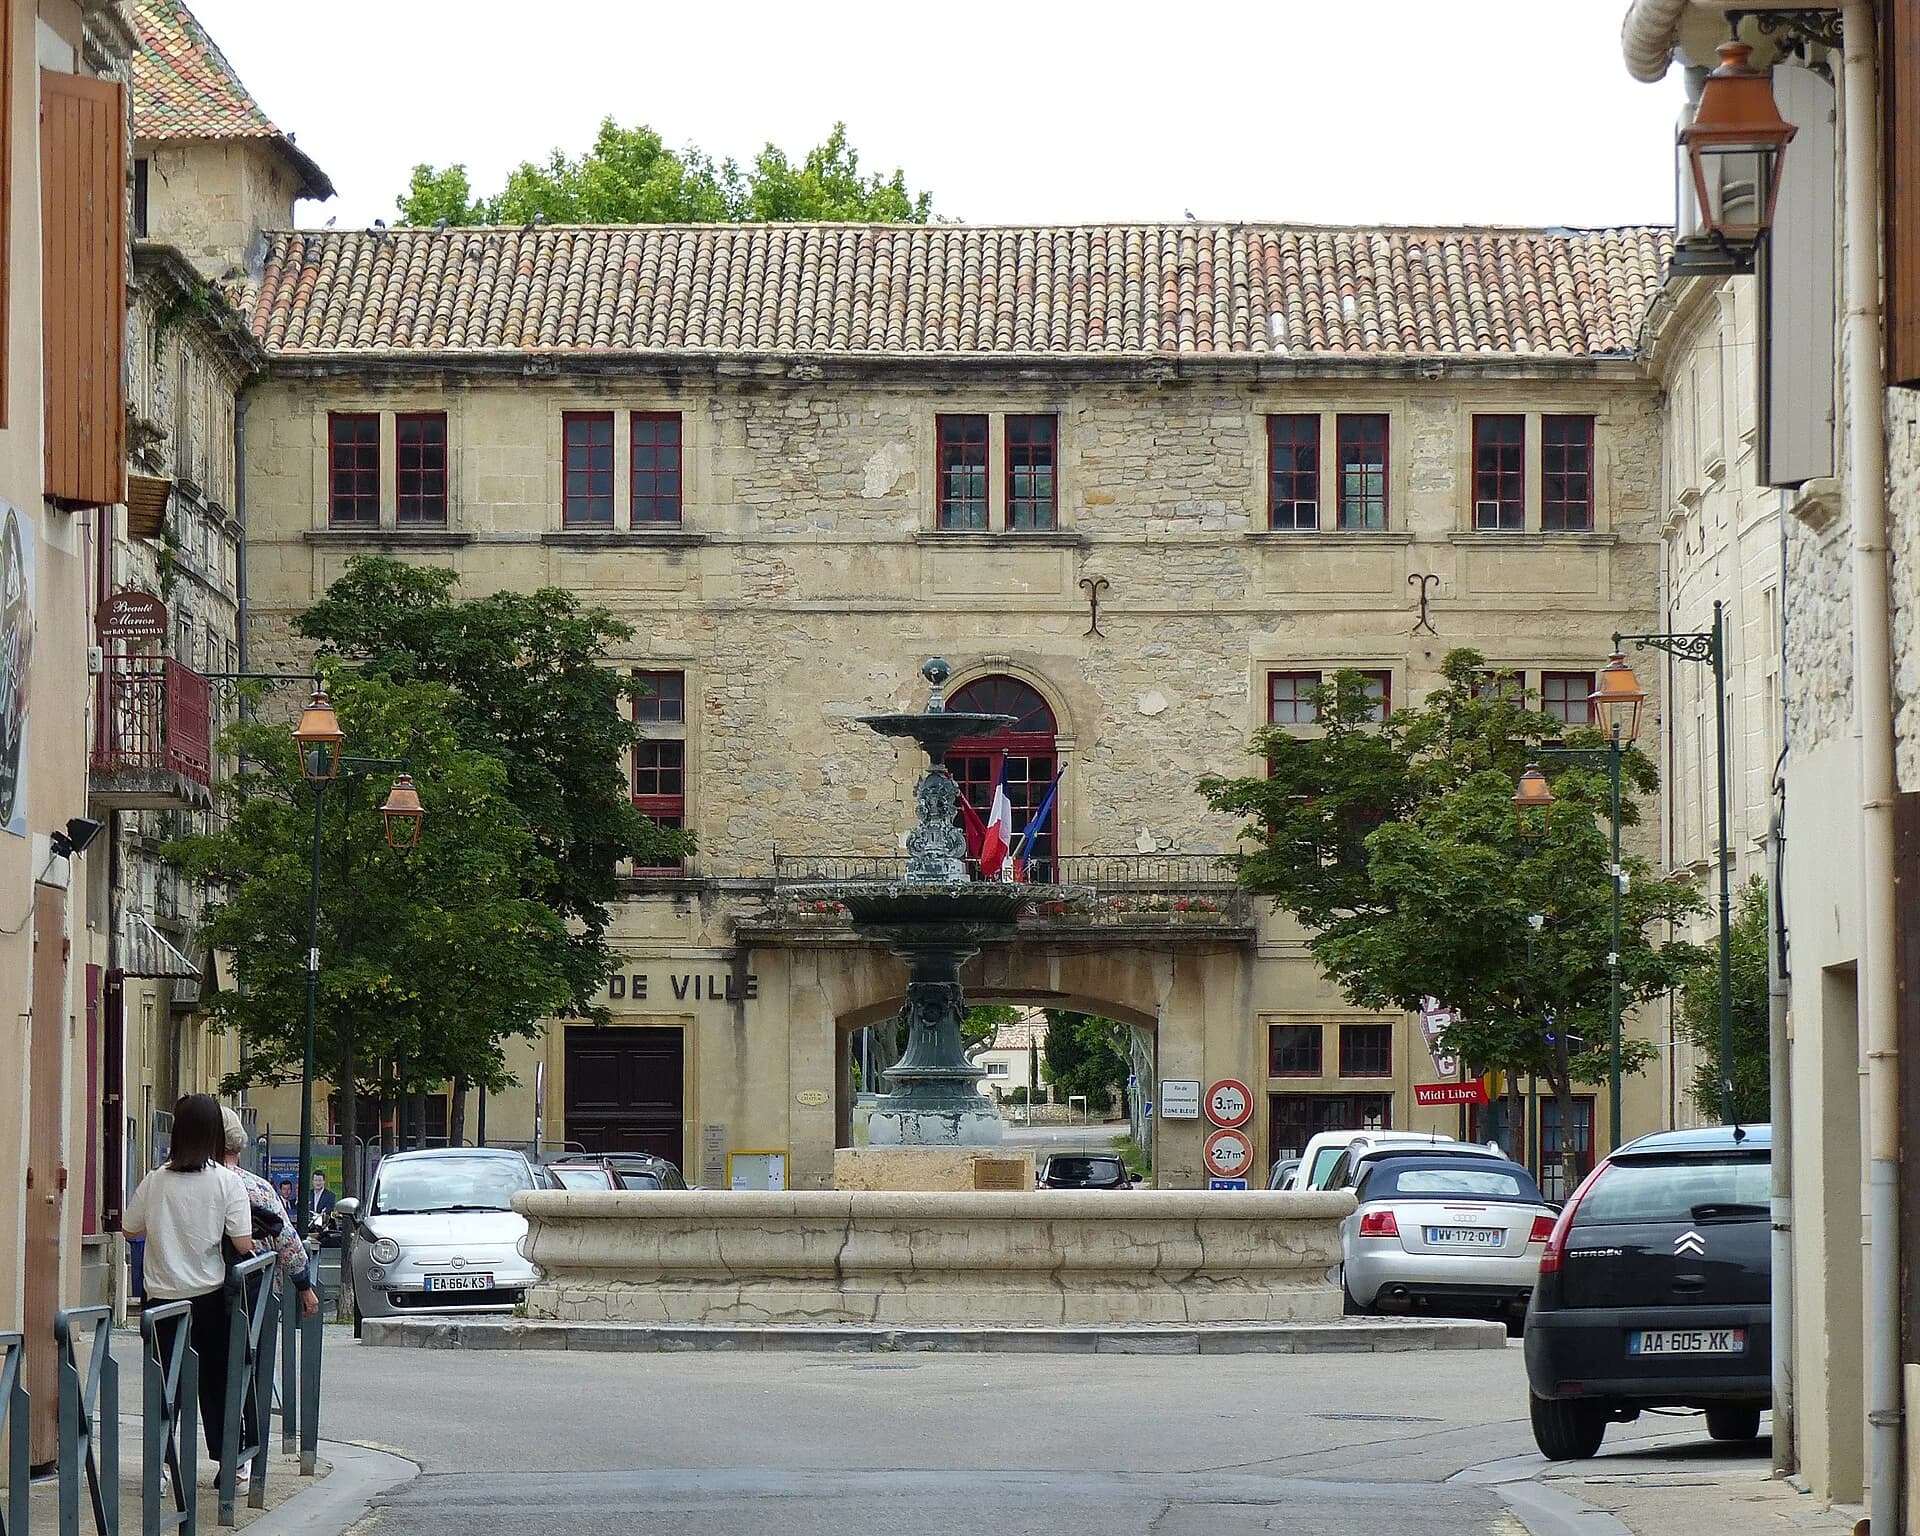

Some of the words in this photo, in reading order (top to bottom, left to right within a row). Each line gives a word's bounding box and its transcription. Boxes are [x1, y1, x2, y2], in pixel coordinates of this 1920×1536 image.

[112, 600, 153, 613] Beauté
[109, 613, 155, 625] Marion
[609, 975, 648, 999] DE
[671, 975, 758, 1000] VILLE
[1420, 1090, 1445, 1100] Midi
[1447, 1089, 1478, 1099] Libre
[1643, 1331, 1730, 1351] AA-605-XK
